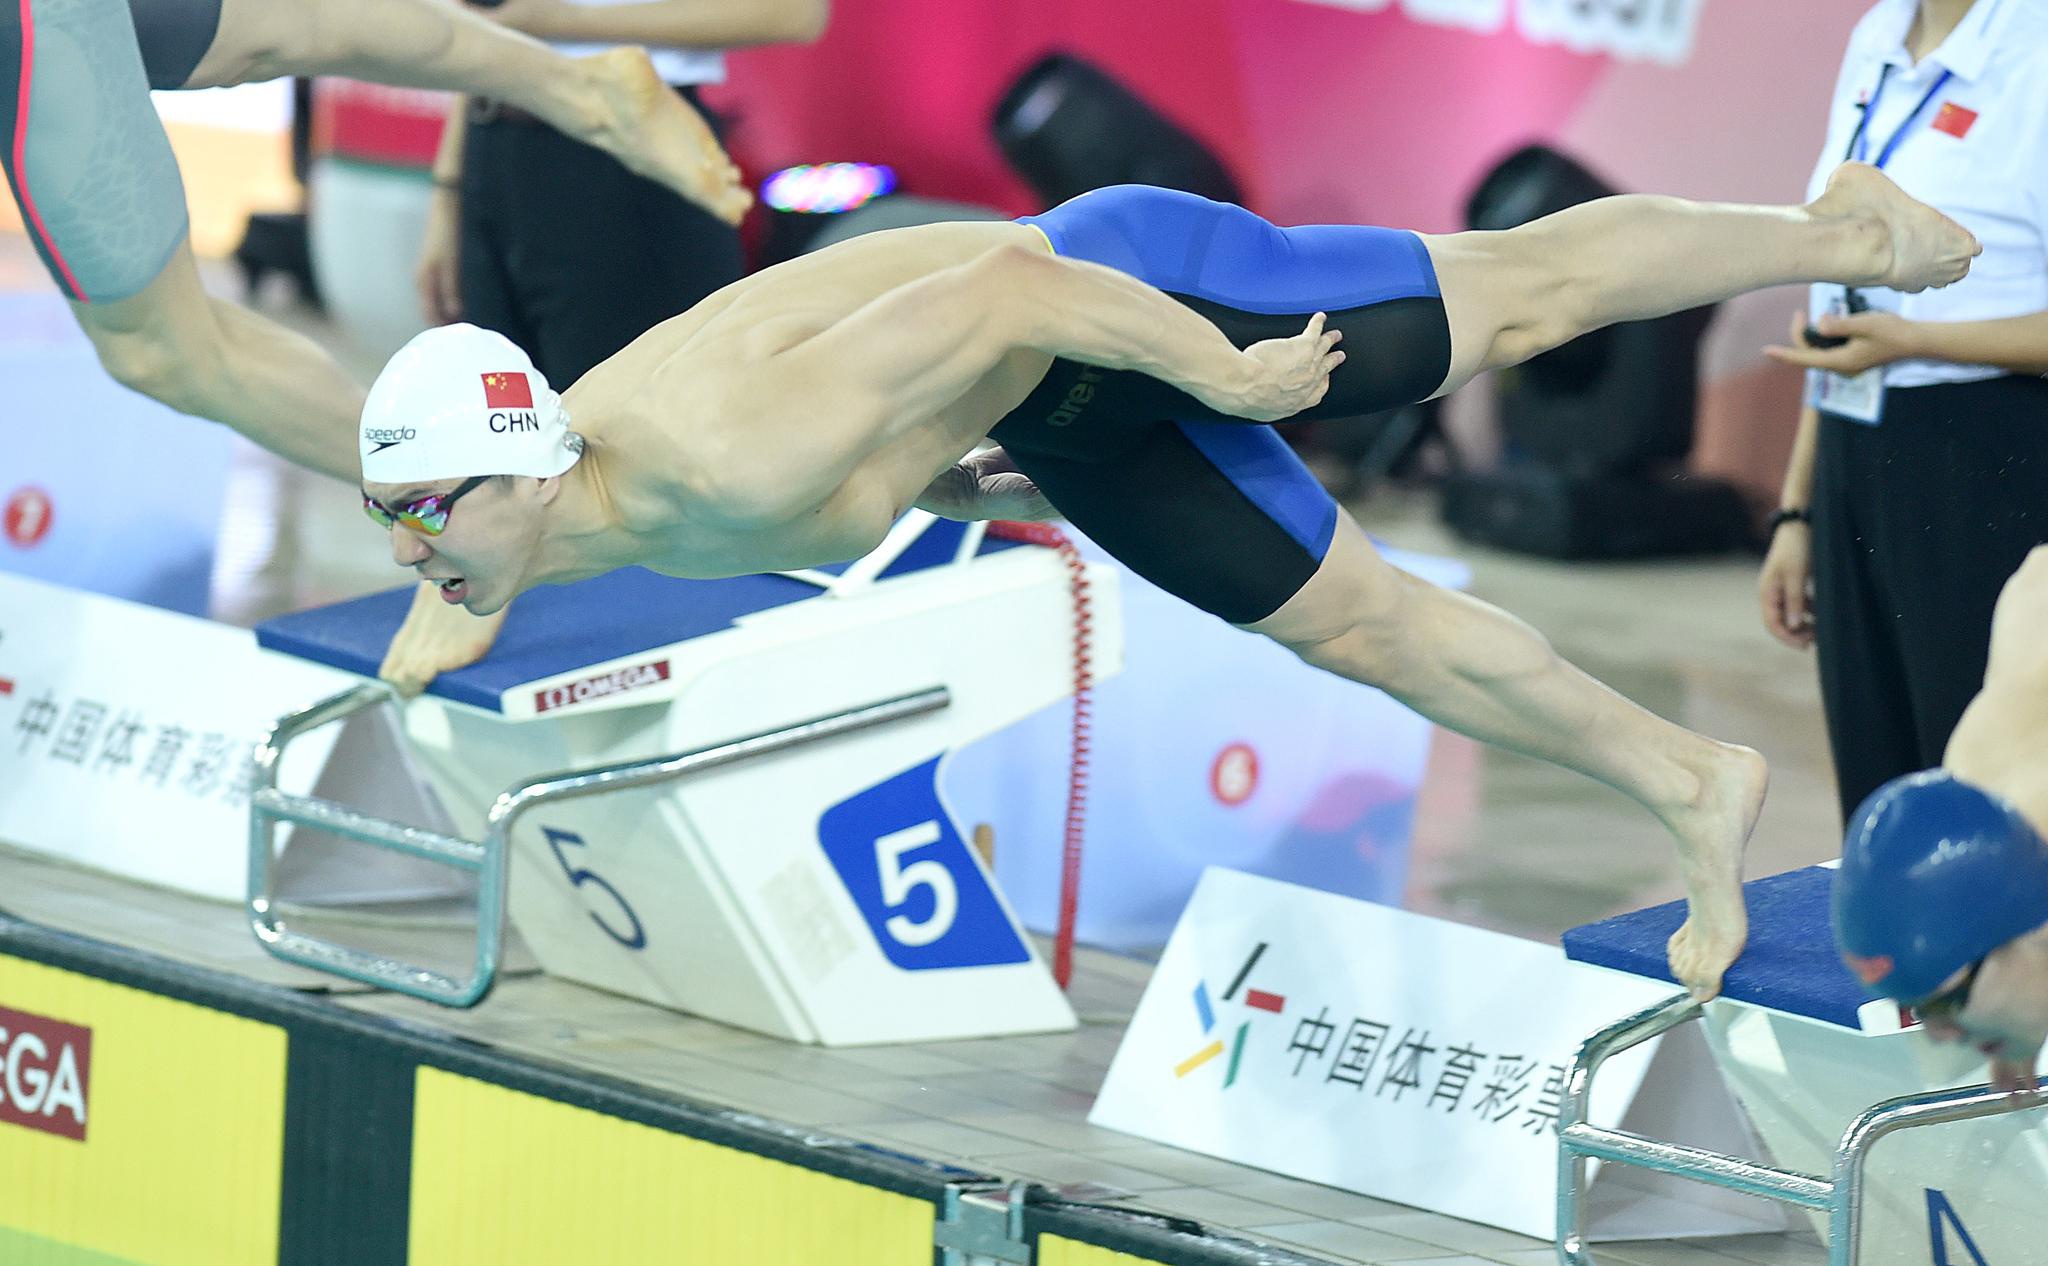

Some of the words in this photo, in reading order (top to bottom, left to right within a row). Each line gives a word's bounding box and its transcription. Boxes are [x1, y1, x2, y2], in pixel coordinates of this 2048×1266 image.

[364, 425, 416, 442] speedo
[489, 412, 540, 433] CHN
[541, 824, 647, 950] 5
[874, 819, 959, 947] 5
[0, 1026, 87, 1125] GA
